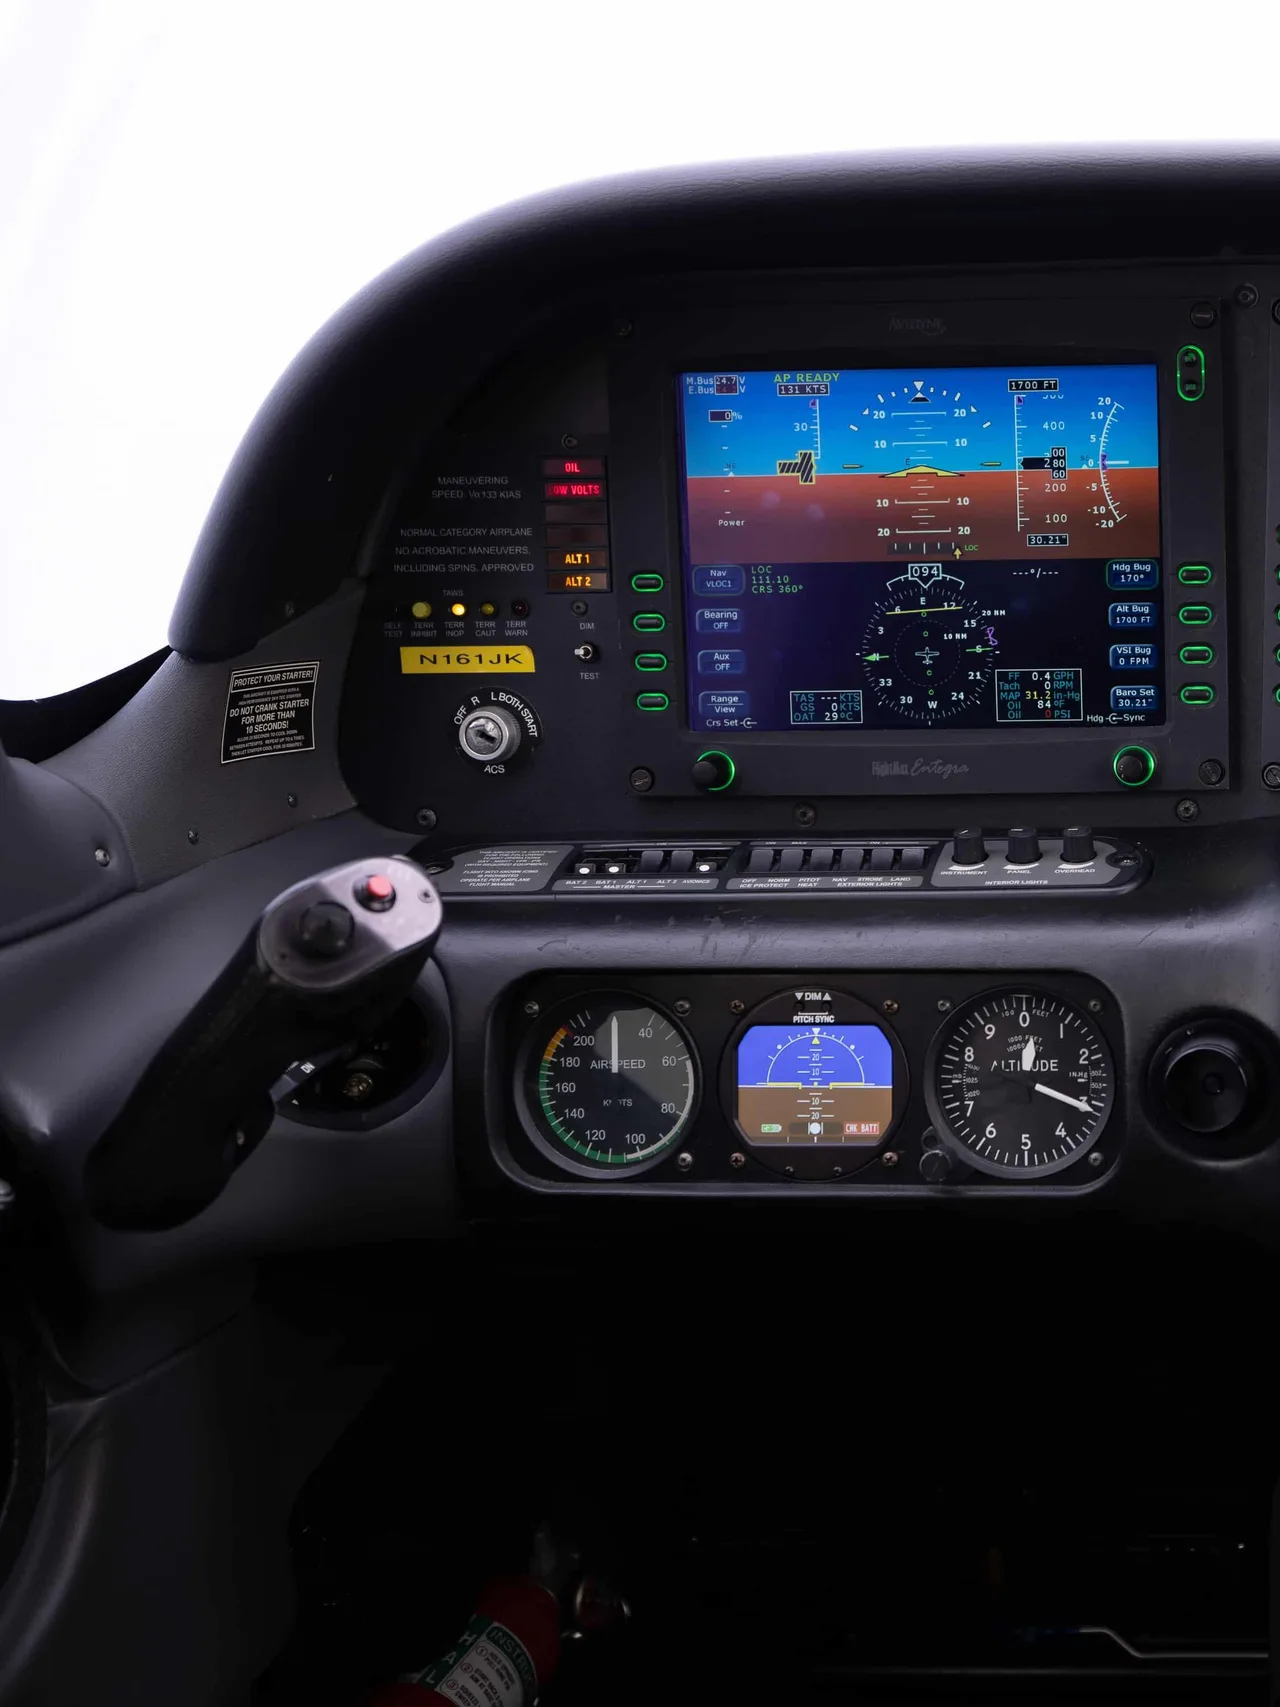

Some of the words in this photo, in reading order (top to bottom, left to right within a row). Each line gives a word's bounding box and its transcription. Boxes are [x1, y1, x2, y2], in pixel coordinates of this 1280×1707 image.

[774, 374, 791, 382] AP
[796, 373, 840, 383] READY
[780, 386, 800, 394] 131
[805, 385, 827, 394] KTS
[1011, 381, 1038, 390] 1700
[1043, 380, 1057, 389] FT
[564, 462, 580, 473] OIL
[570, 484, 600, 496] VOLTS
[400, 528, 438, 537] NORMAL
[440, 527, 487, 537] CATEGORY
[489, 527, 534, 536] AIRPLANE
[565, 553, 583, 564] ALT
[585, 553, 590, 564] 1
[751, 565, 772, 574] LOC
[912, 566, 938, 577] 094
[1112, 563, 1129, 572] Hdg
[1133, 563, 1151, 572] Bug
[710, 569, 727, 577] Nav
[565, 576, 583, 587] ALT
[584, 576, 591, 587] 2
[706, 580, 731, 588] VLOC1
[751, 575, 789, 584] 111.10
[752, 585, 773, 594] CRS
[1116, 605, 1129, 613] Alt
[1132, 605, 1149, 614] Bug
[704, 611, 738, 620] Bearing
[420, 653, 523, 666] N161JK
[234, 675, 262, 688] PROTECT
[263, 674, 281, 684] YOUR
[282, 670, 313, 681] STARTER!
[1139, 688, 1155, 696] Set
[711, 695, 739, 704] Range
[229, 709, 240, 718] DO
[240, 706, 254, 716] NOT
[254, 703, 278, 713] CRANK
[279, 698, 310, 710] STARTER
[714, 705, 735, 713] View
[453, 705, 467, 727] OFF
[498, 693, 524, 711] BOTH
[520, 707, 538, 738] START
[484, 764, 505, 774] ACS
[804, 993, 822, 1001] DIM
[793, 1015, 814, 1023] PITCH
[815, 1015, 835, 1023] SYNC
[573, 1035, 595, 1047] 200
[964, 1046, 974, 1062] 8
[560, 1057, 580, 1068] 180
[555, 1082, 576, 1093] 160
[564, 1108, 584, 1119] 140
[845, 1123, 858, 1132] CHK
[861, 1123, 878, 1132] BATT
[585, 1129, 606, 1141] 120
[625, 1133, 646, 1144] 100
[1021, 1134, 1031, 1150] 5
